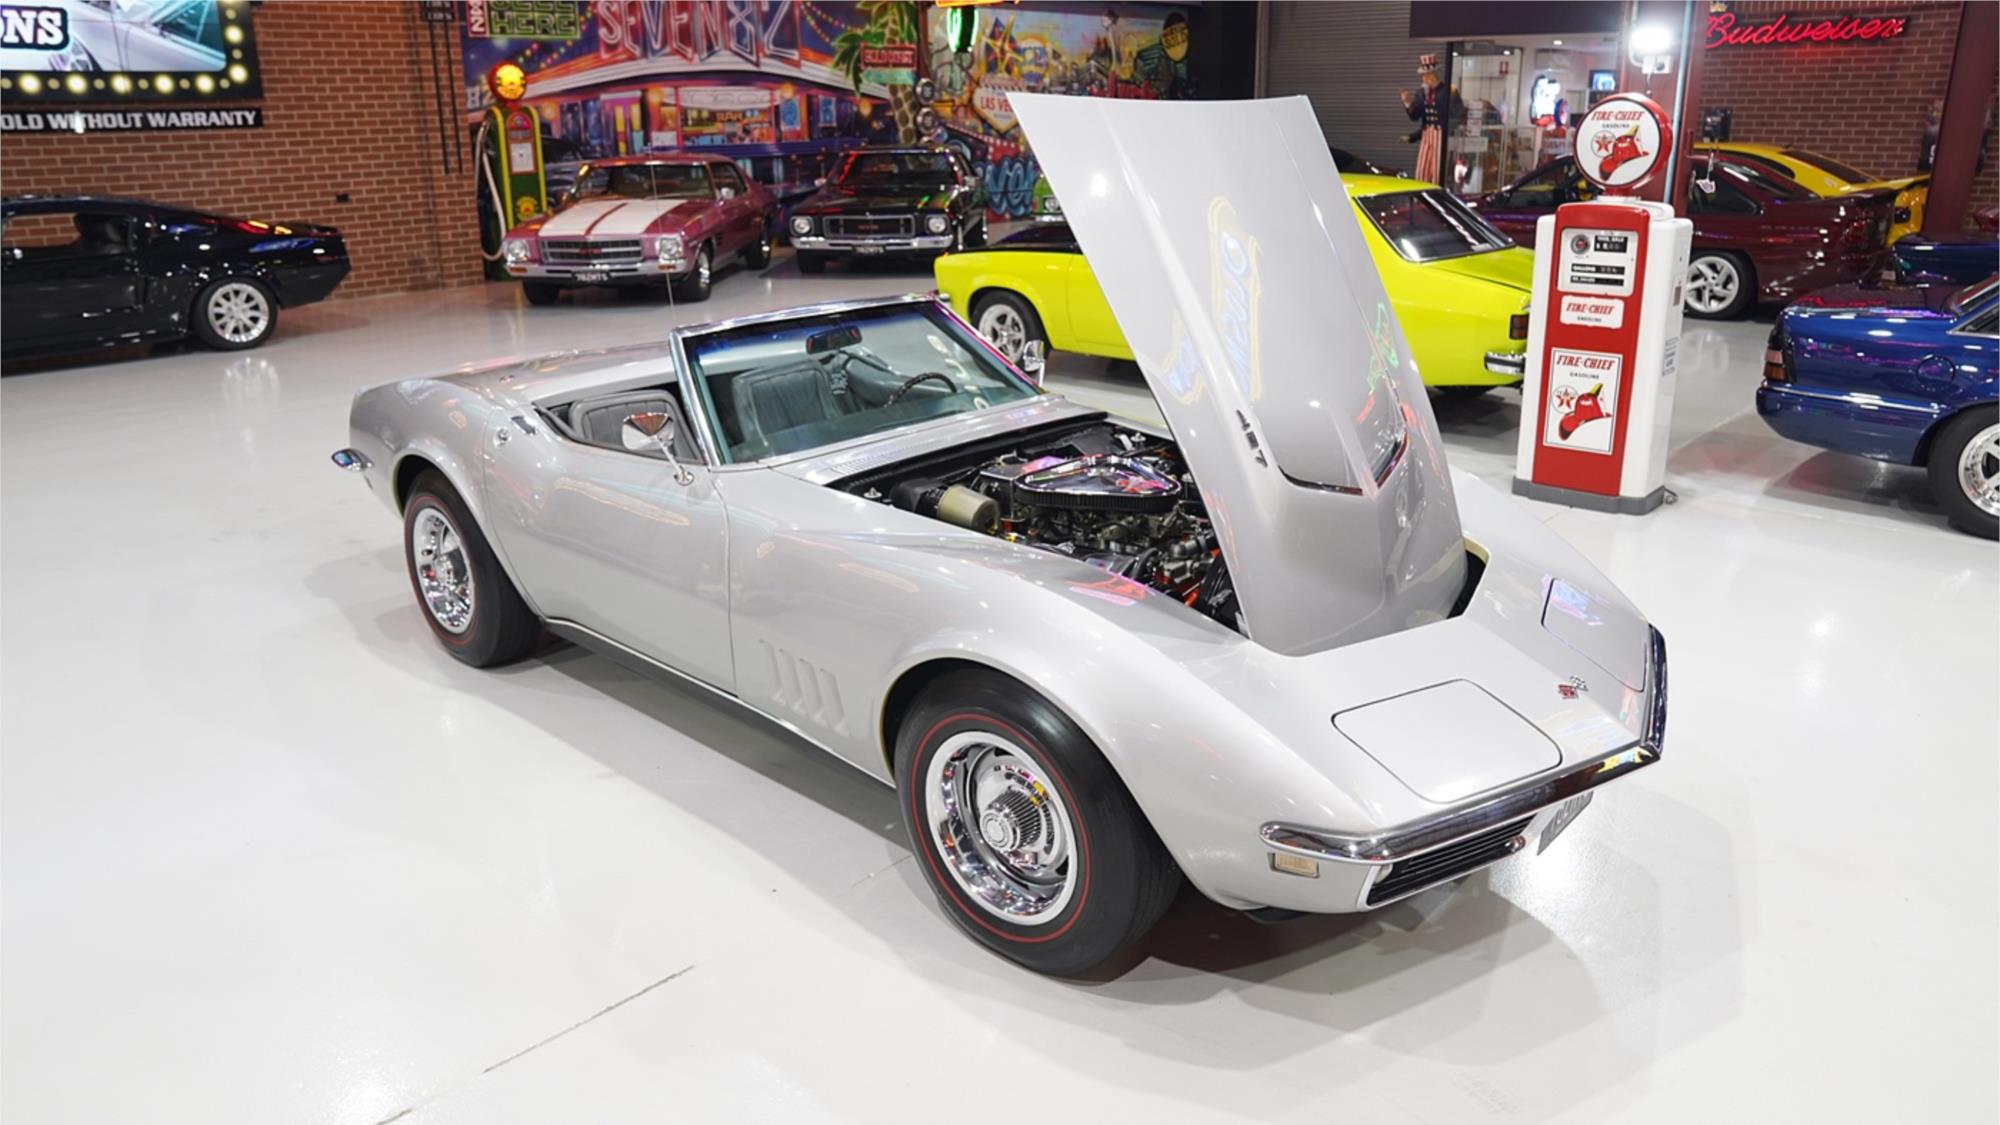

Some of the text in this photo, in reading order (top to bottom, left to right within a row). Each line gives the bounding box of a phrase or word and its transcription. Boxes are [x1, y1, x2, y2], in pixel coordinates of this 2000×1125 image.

[0, 8, 64, 46] NS
[490, 11, 576, 35] HERE
[1705, 12, 1905, 49] Budweiser
[46, 112, 142, 130] WITHOUT
[147, 110, 256, 128] WARRANTY
[1556, 355, 1616, 370] FIRE-CHIEF
